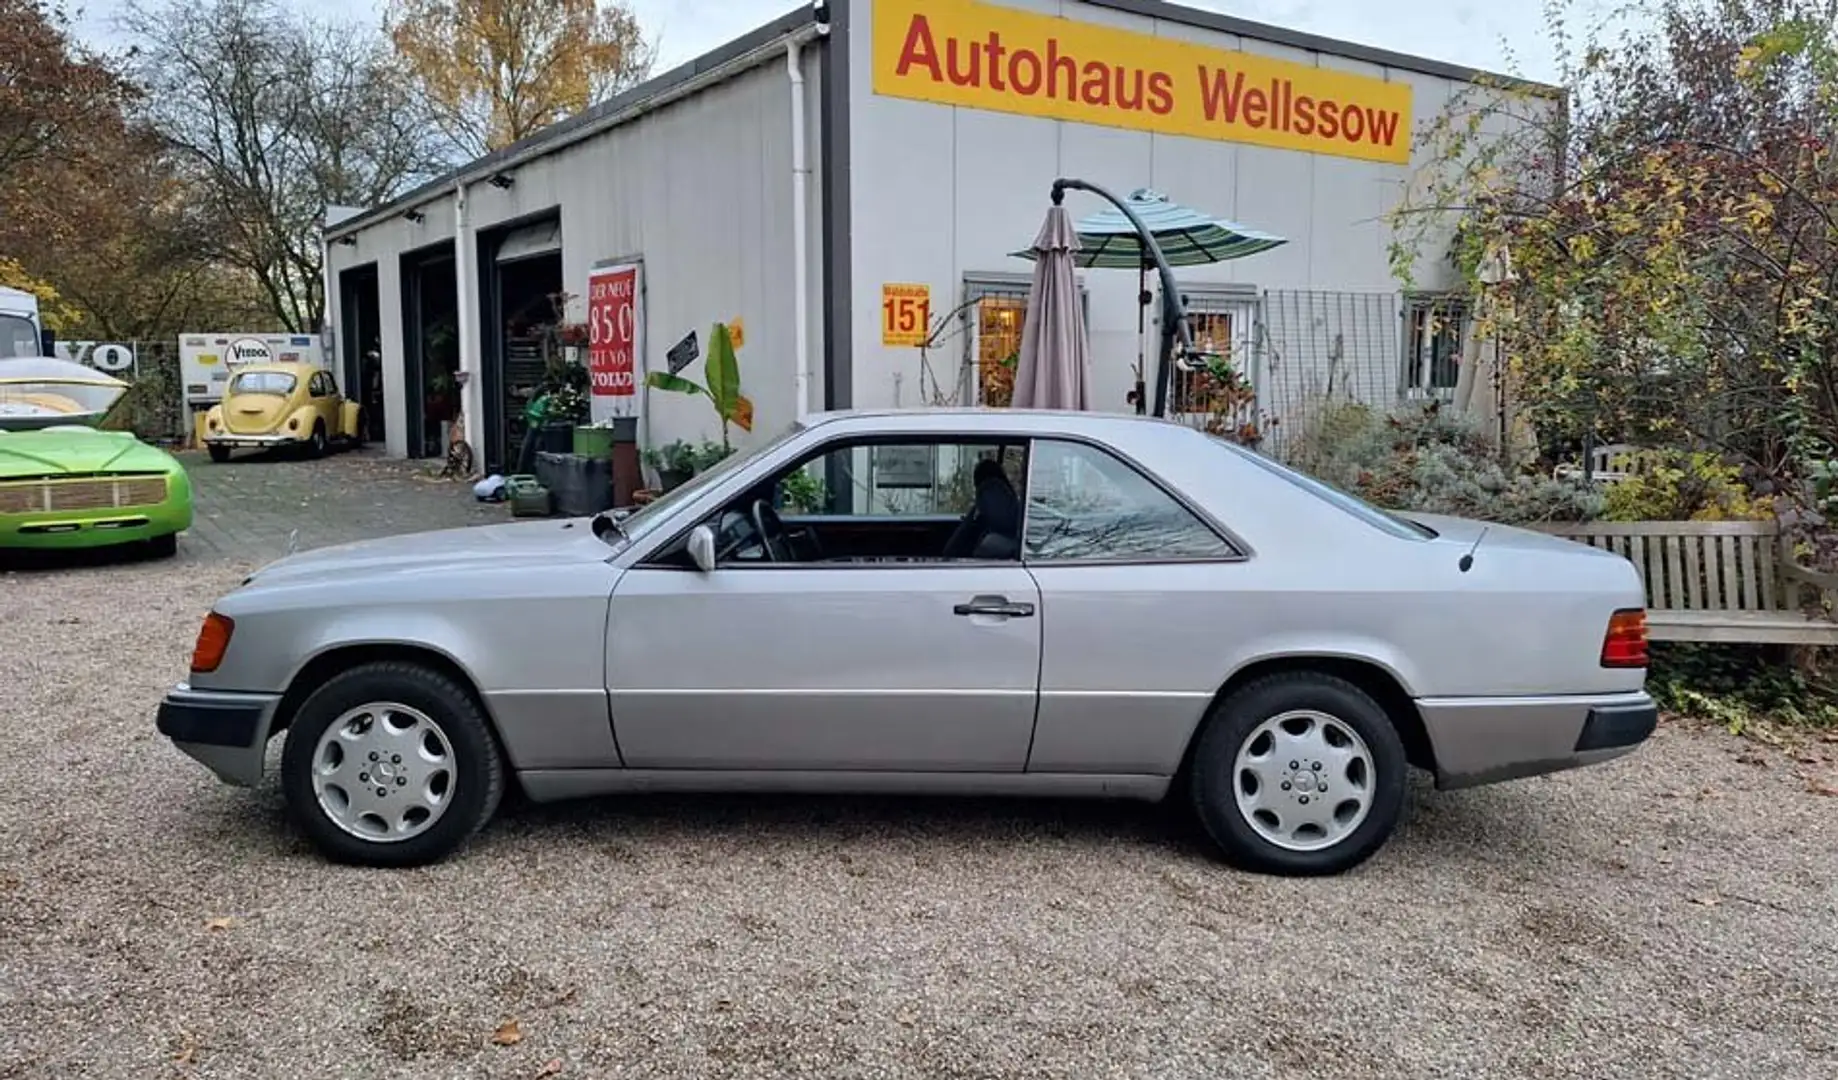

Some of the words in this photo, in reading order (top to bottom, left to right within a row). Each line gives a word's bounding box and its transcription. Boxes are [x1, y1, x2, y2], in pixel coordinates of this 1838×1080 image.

[896, 14, 1173, 115] Autohaus
[1198, 64, 1398, 146] Wellssow
[590, 303, 632, 344] 850
[883, 299, 929, 331] 151
